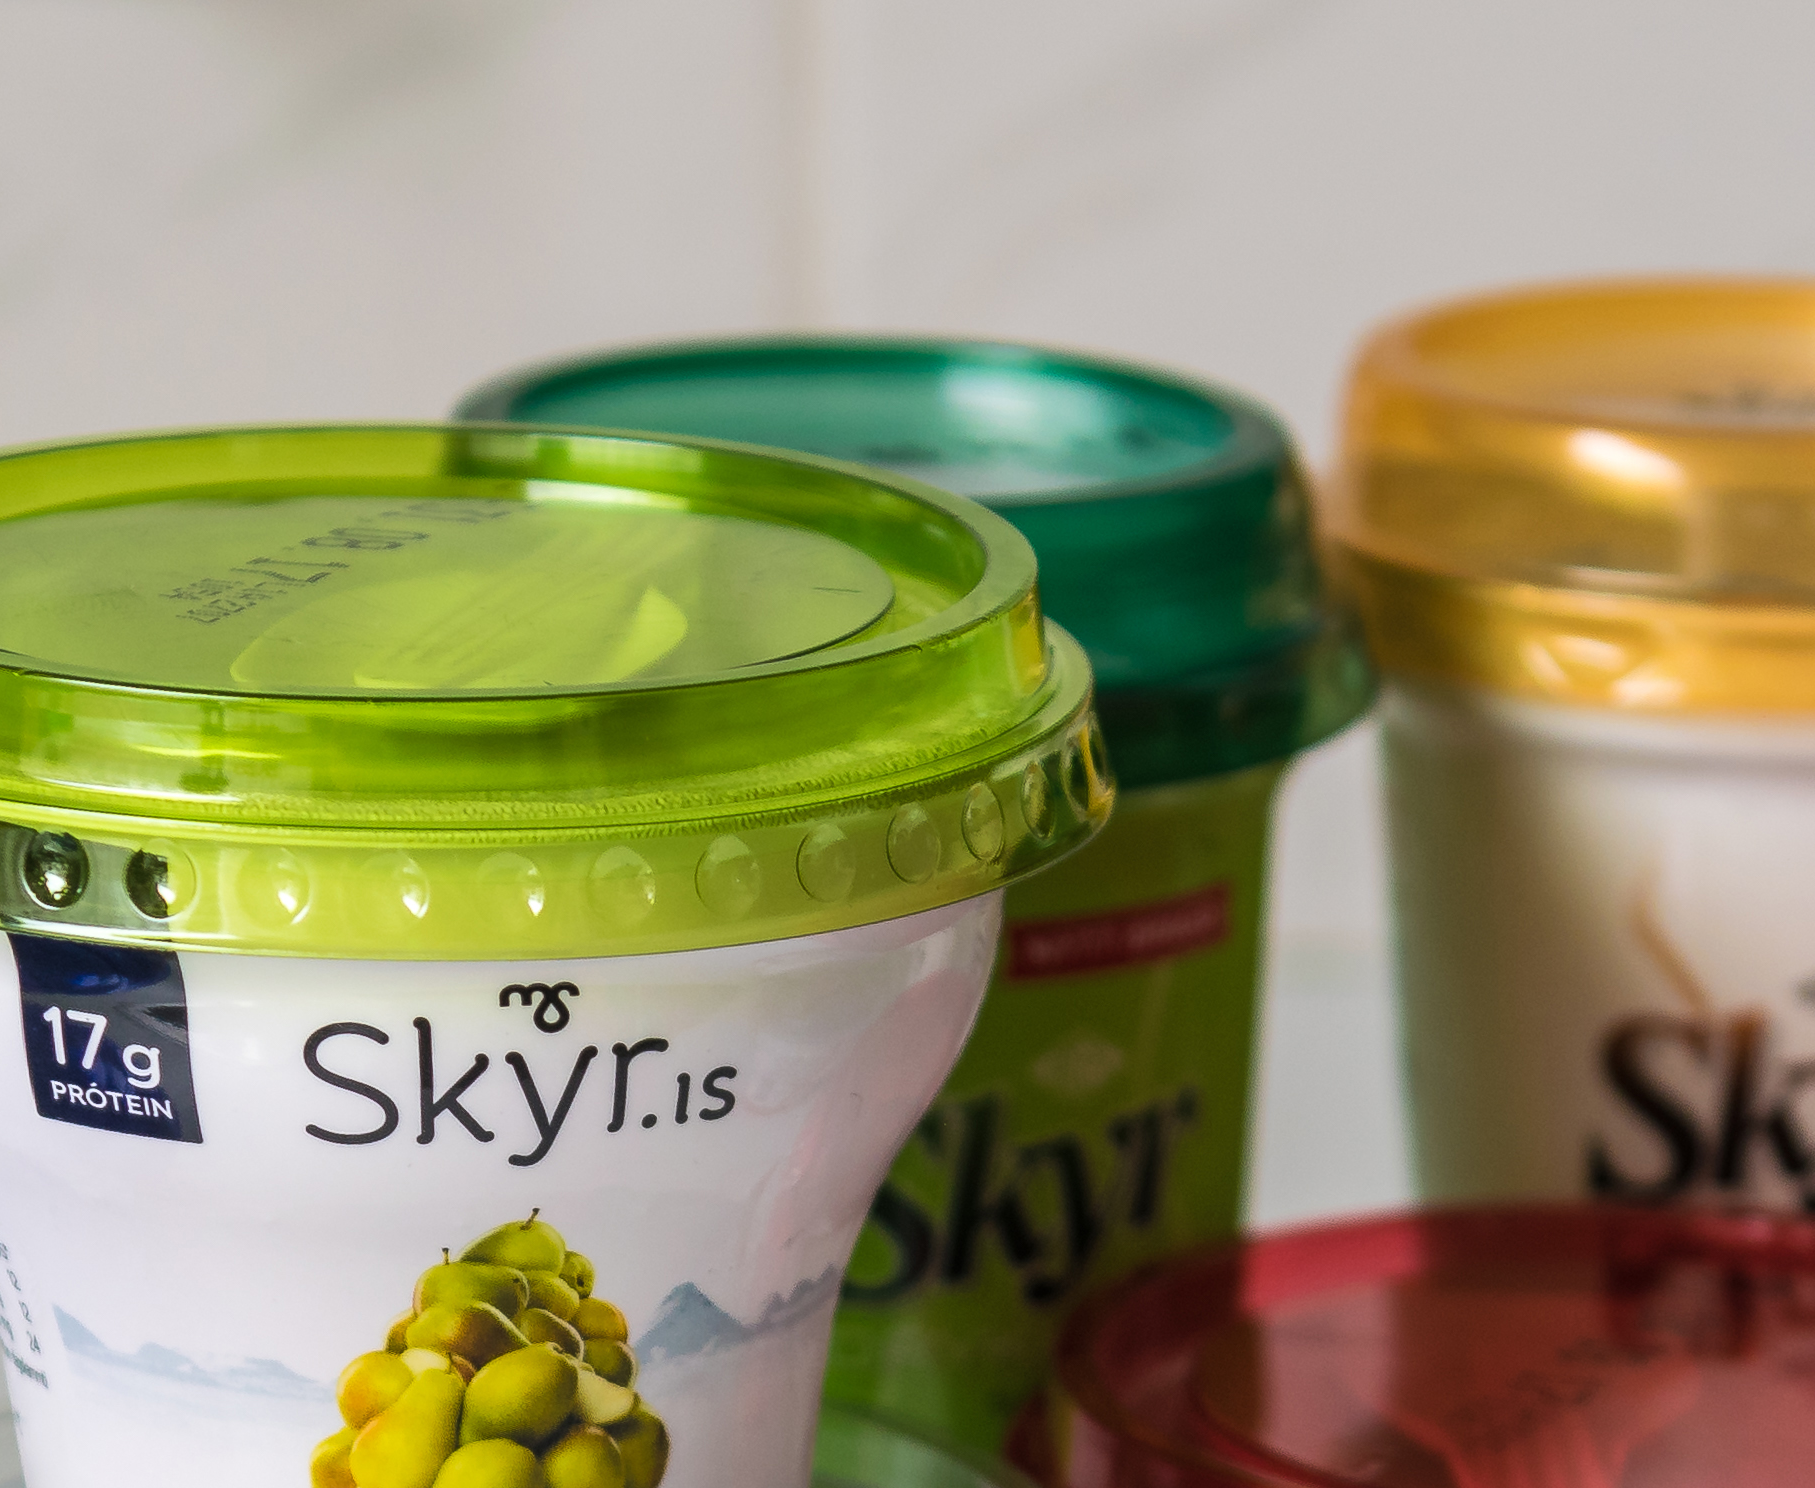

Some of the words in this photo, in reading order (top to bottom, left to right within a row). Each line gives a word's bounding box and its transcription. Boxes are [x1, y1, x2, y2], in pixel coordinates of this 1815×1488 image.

[44, 1005, 107, 1069] 17
[123, 1044, 162, 1088] g
[51, 1081, 173, 1120] PRÓTEIN
